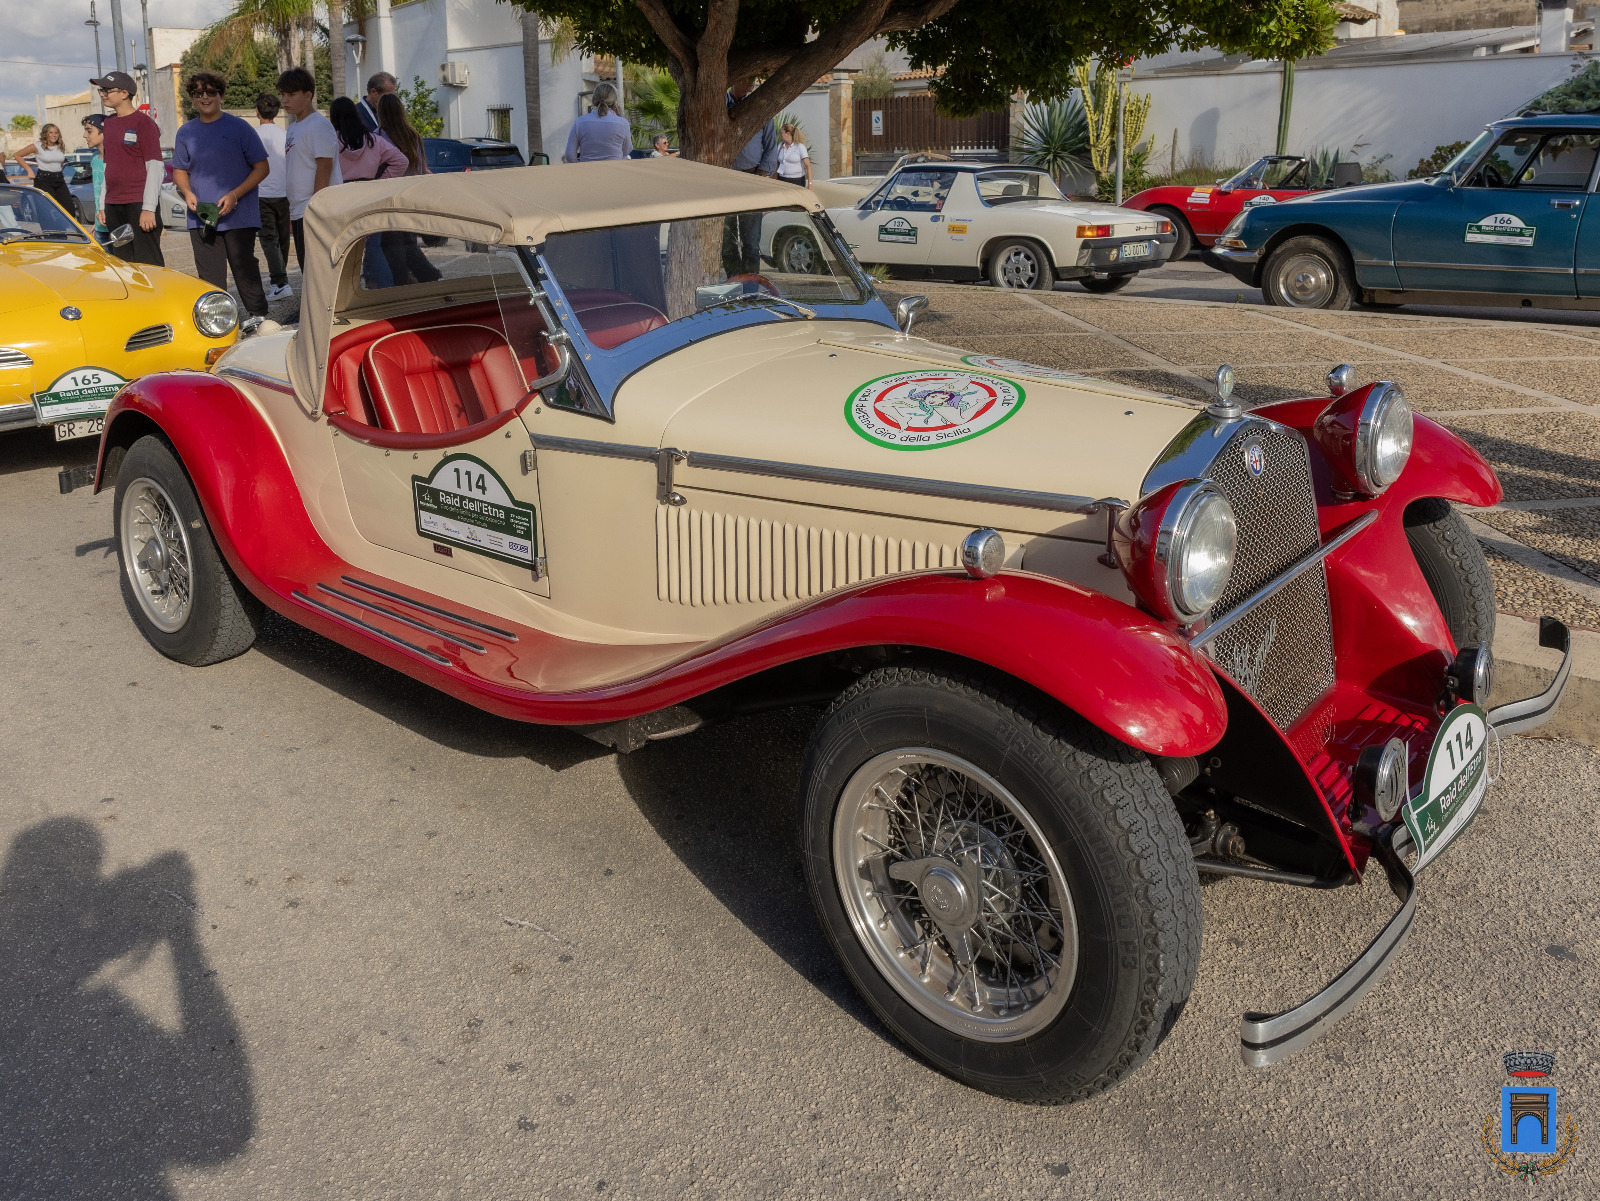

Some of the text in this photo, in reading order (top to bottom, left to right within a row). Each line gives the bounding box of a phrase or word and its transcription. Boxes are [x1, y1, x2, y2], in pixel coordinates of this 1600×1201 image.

[893, 220, 904, 228] 137
[1494, 216, 1512, 225] 166
[71, 373, 102, 387] 165
[59, 385, 119, 398] Raid dell'Etna
[57, 422, 76, 438] GR
[874, 424, 897, 441] Giro
[900, 433, 931, 443] della
[935, 426, 972, 441] Sicilia
[453, 467, 488, 496] 114
[439, 491, 461, 508] Raid
[462, 497, 506, 519] dell'Etna
[1446, 721, 1474, 771] 114
[1439, 784, 1458, 814] Raid
[1457, 751, 1483, 795] dell'Etna
